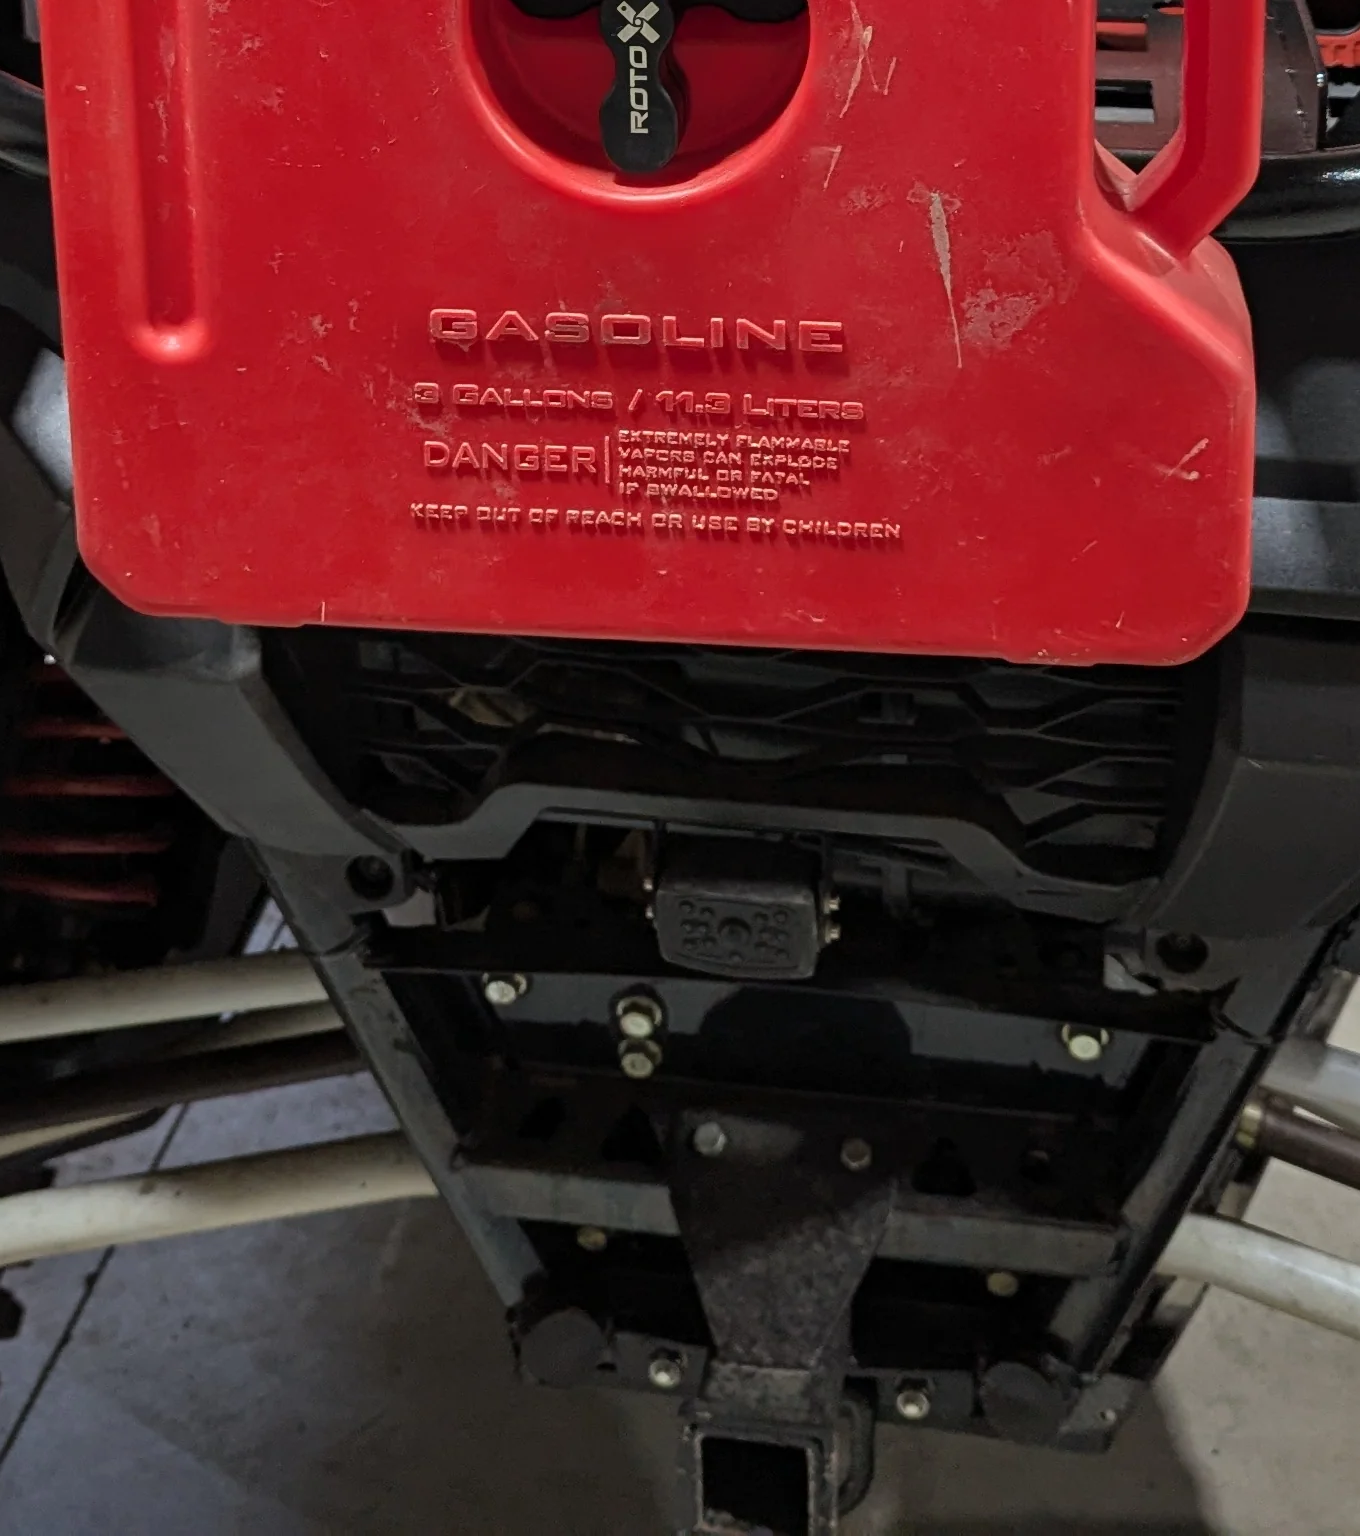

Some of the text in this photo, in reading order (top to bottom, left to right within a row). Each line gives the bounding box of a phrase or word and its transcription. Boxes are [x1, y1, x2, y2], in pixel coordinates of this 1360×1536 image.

[628, 45, 649, 134] ROTO
[429, 307, 843, 353] GASOLINE
[413, 382, 440, 405] 3
[452, 383, 614, 410] GALLONS
[655, 390, 732, 415] 11.3
[742, 392, 865, 421] LITERS
[423, 440, 597, 474] DANGER
[617, 429, 851, 453] EXTREMELY FLAMMABLE
[617, 464, 811, 486] HARMFUL OR FATAL
[702, 450, 743, 465] CAN
[750, 453, 838, 470] EXPLODE
[618, 481, 640, 495] IF
[409, 502, 901, 539] KEEP OUT OF REACH OR USE BY CHILDREN
